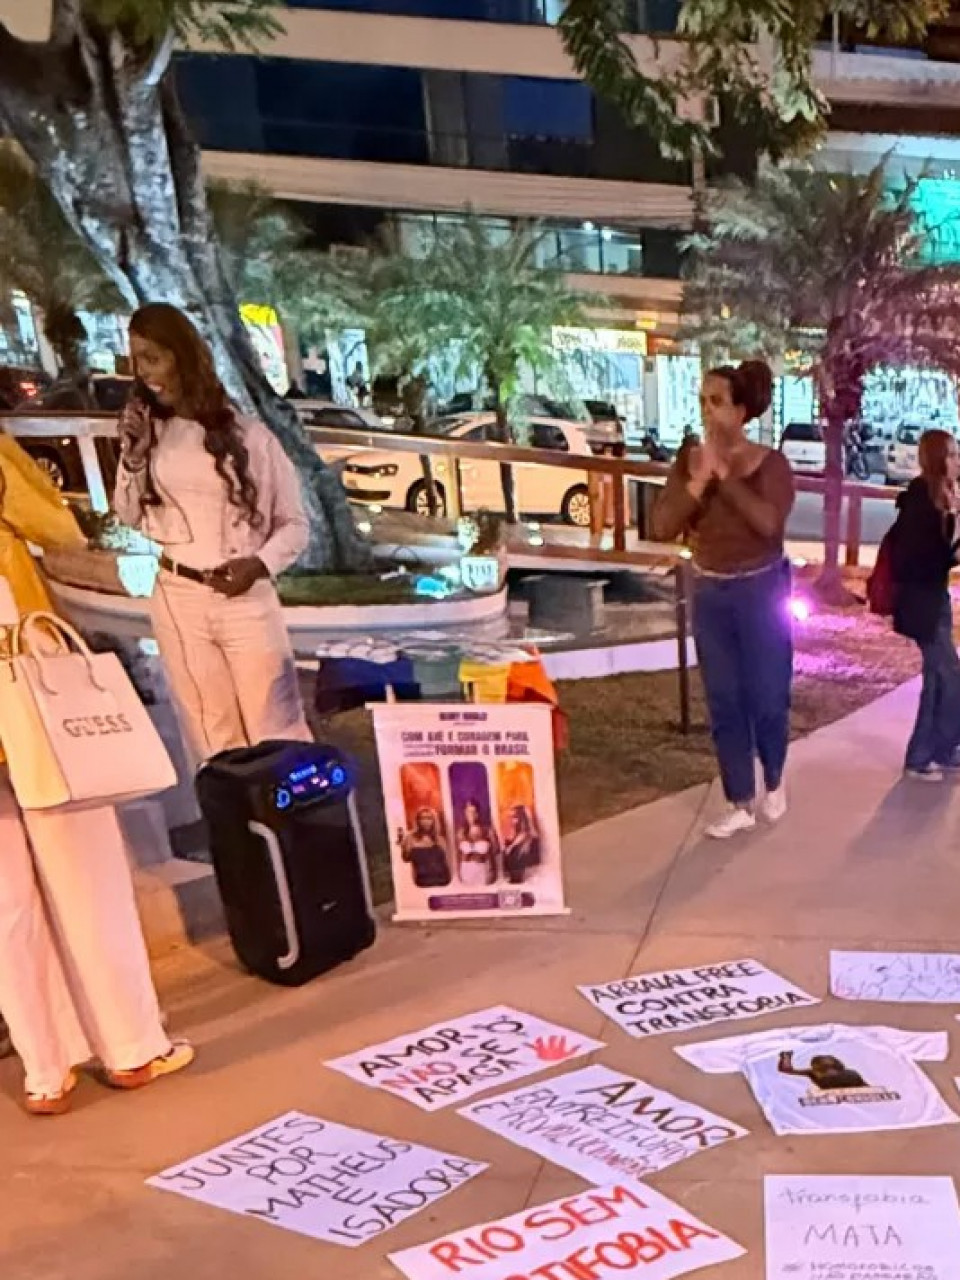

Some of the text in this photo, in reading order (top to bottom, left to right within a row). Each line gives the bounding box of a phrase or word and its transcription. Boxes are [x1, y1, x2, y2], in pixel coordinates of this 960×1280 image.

[62, 713, 134, 737] GUESS
[693, 961, 763, 983] FREE
[616, 983, 747, 1015] CONTRA
[627, 991, 812, 1034] TRANSFOBIA
[359, 1027, 478, 1077] AMOR
[460, 1038, 519, 1064] SE
[414, 1058, 521, 1103] APAGA
[576, 1080, 737, 1147] AMOR
[161, 1117, 325, 1190] JUNTES
[245, 1146, 340, 1185] POR
[246, 1139, 412, 1220] MATHEUS
[329, 1158, 474, 1240] ISADORA
[331, 1186, 378, 1208] E
[429, 1185, 650, 1272] RIO SEM
[804, 1222, 903, 1248] MATA
